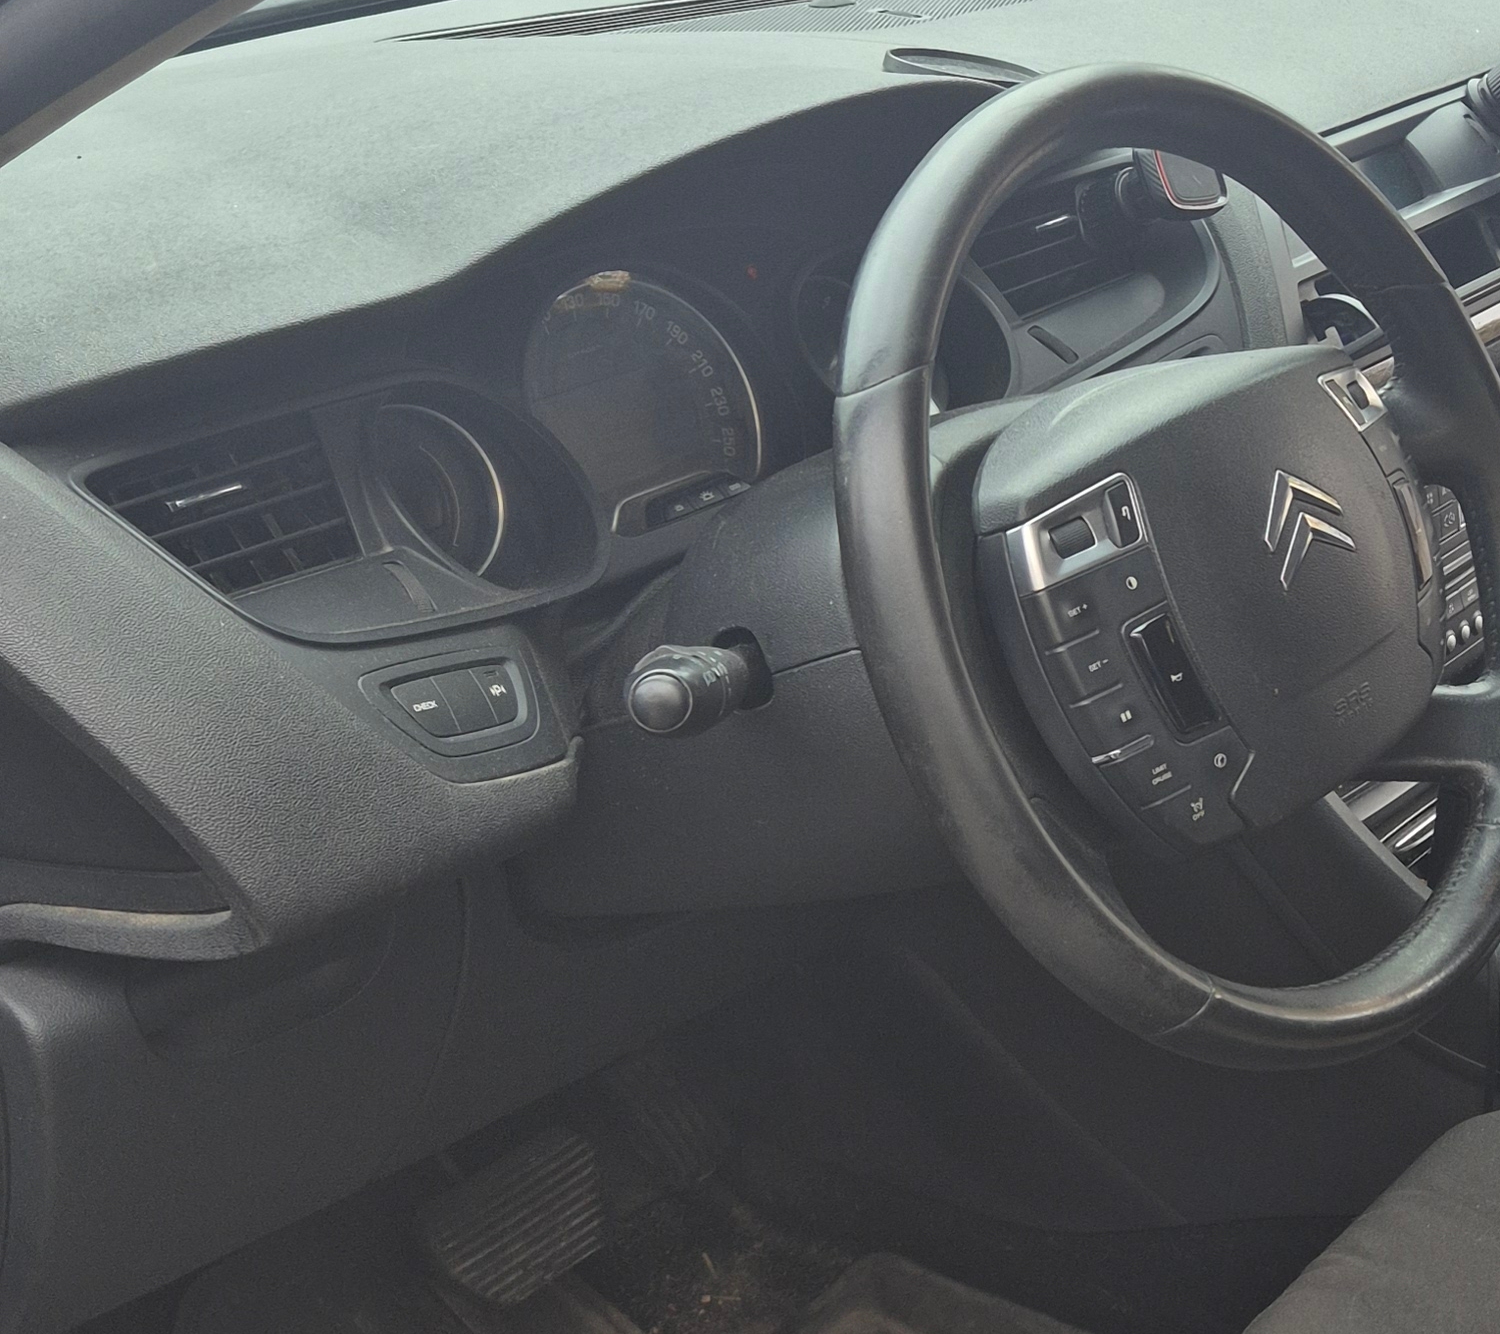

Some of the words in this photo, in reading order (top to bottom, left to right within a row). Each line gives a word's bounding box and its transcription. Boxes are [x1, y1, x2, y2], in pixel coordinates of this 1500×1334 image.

[634, 300, 656, 321] 170
[667, 320, 689, 345] 190
[691, 349, 714, 378] 210
[710, 386, 730, 416] 230
[721, 427, 736, 457] 250
